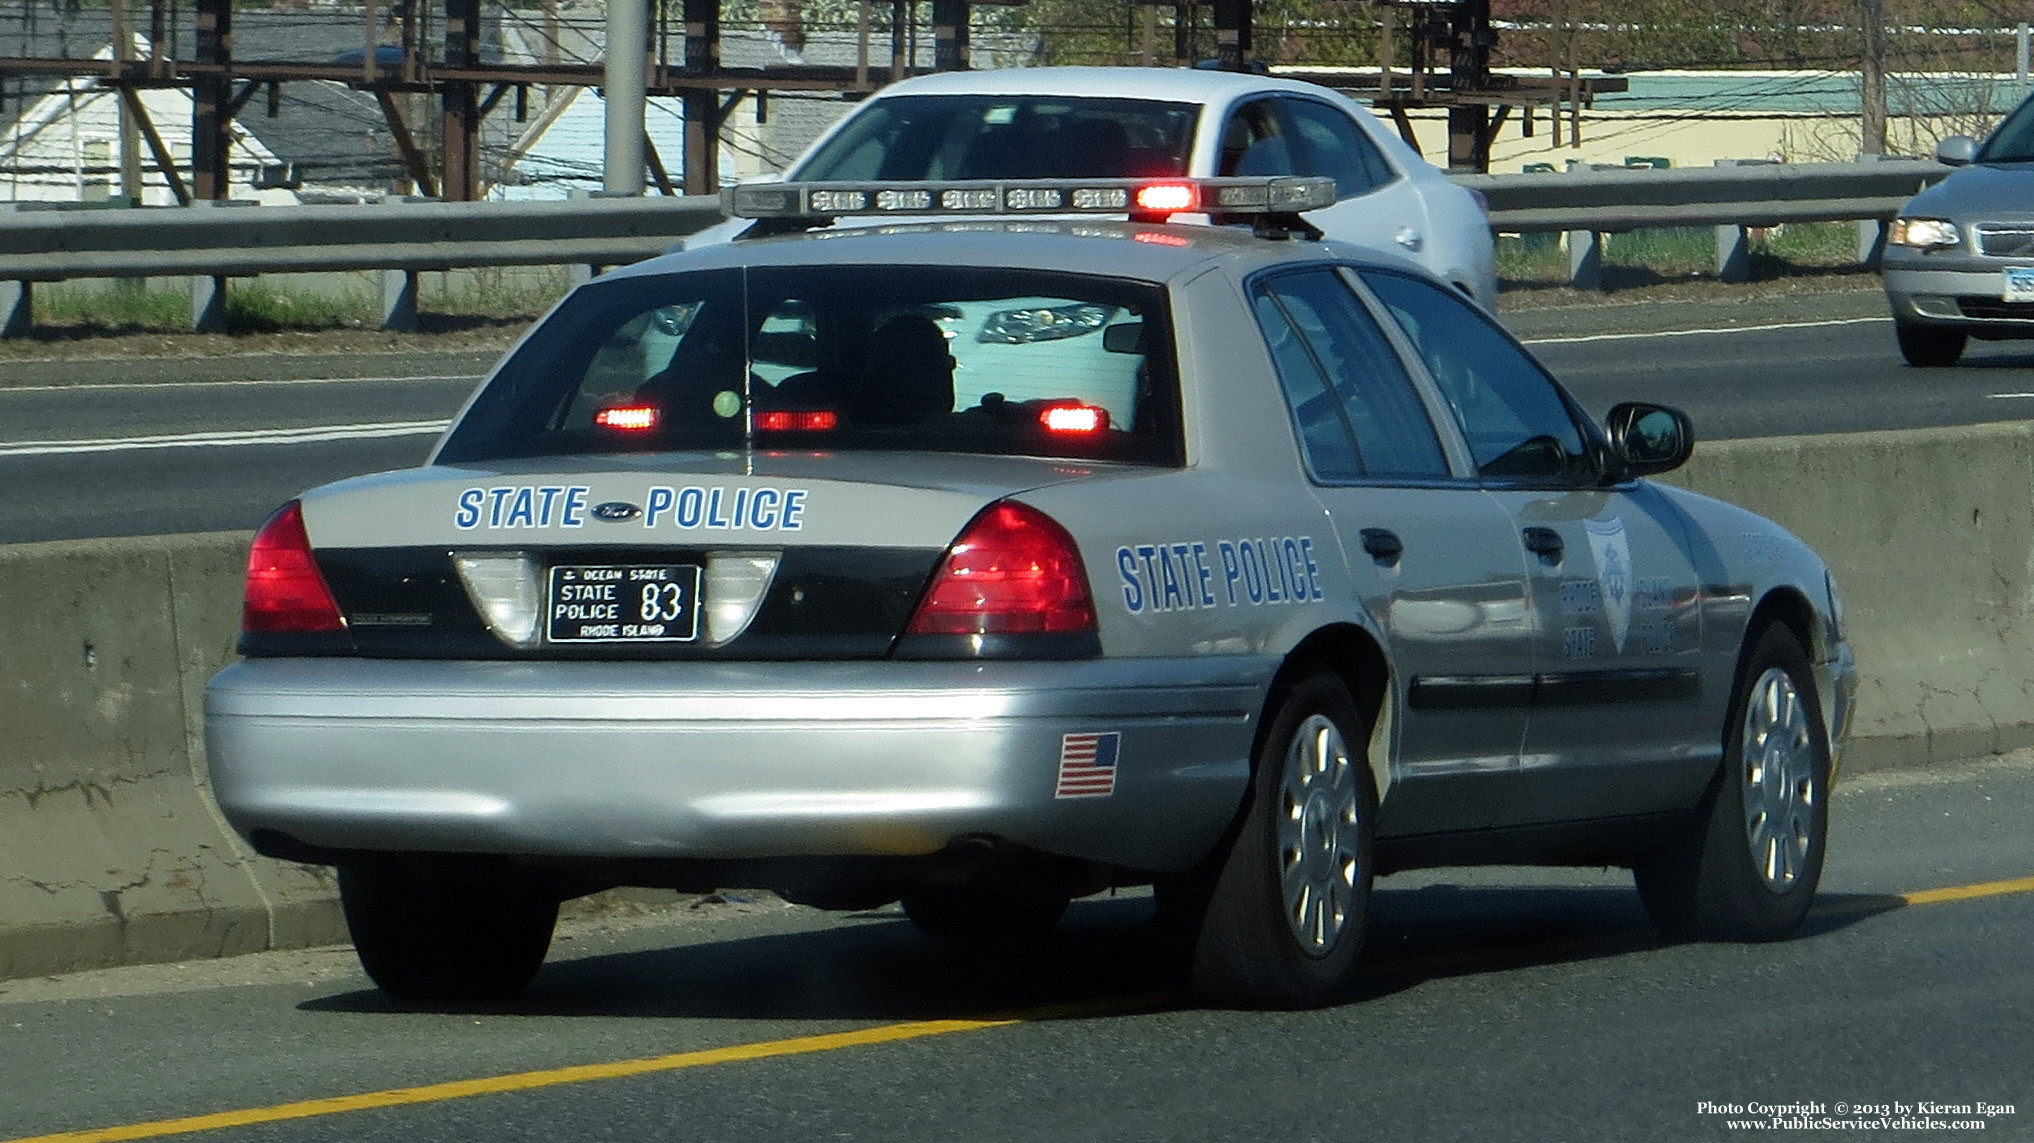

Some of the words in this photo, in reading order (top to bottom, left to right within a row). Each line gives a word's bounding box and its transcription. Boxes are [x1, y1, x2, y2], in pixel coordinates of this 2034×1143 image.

[455, 486, 590, 529] STATE
[643, 487, 808, 532] POLICE
[583, 570, 622, 581] OCEAN
[629, 569, 667, 580] STATE
[1116, 541, 1216, 614] STATE
[1217, 536, 1324, 607] POLICE
[560, 585, 617, 601] STATE
[640, 583, 682, 621] 83
[555, 604, 620, 620] POLICE
[580, 625, 618, 637] RHODE
[622, 625, 665, 637] ISLAND
[1563, 626, 1596, 657] STATE
